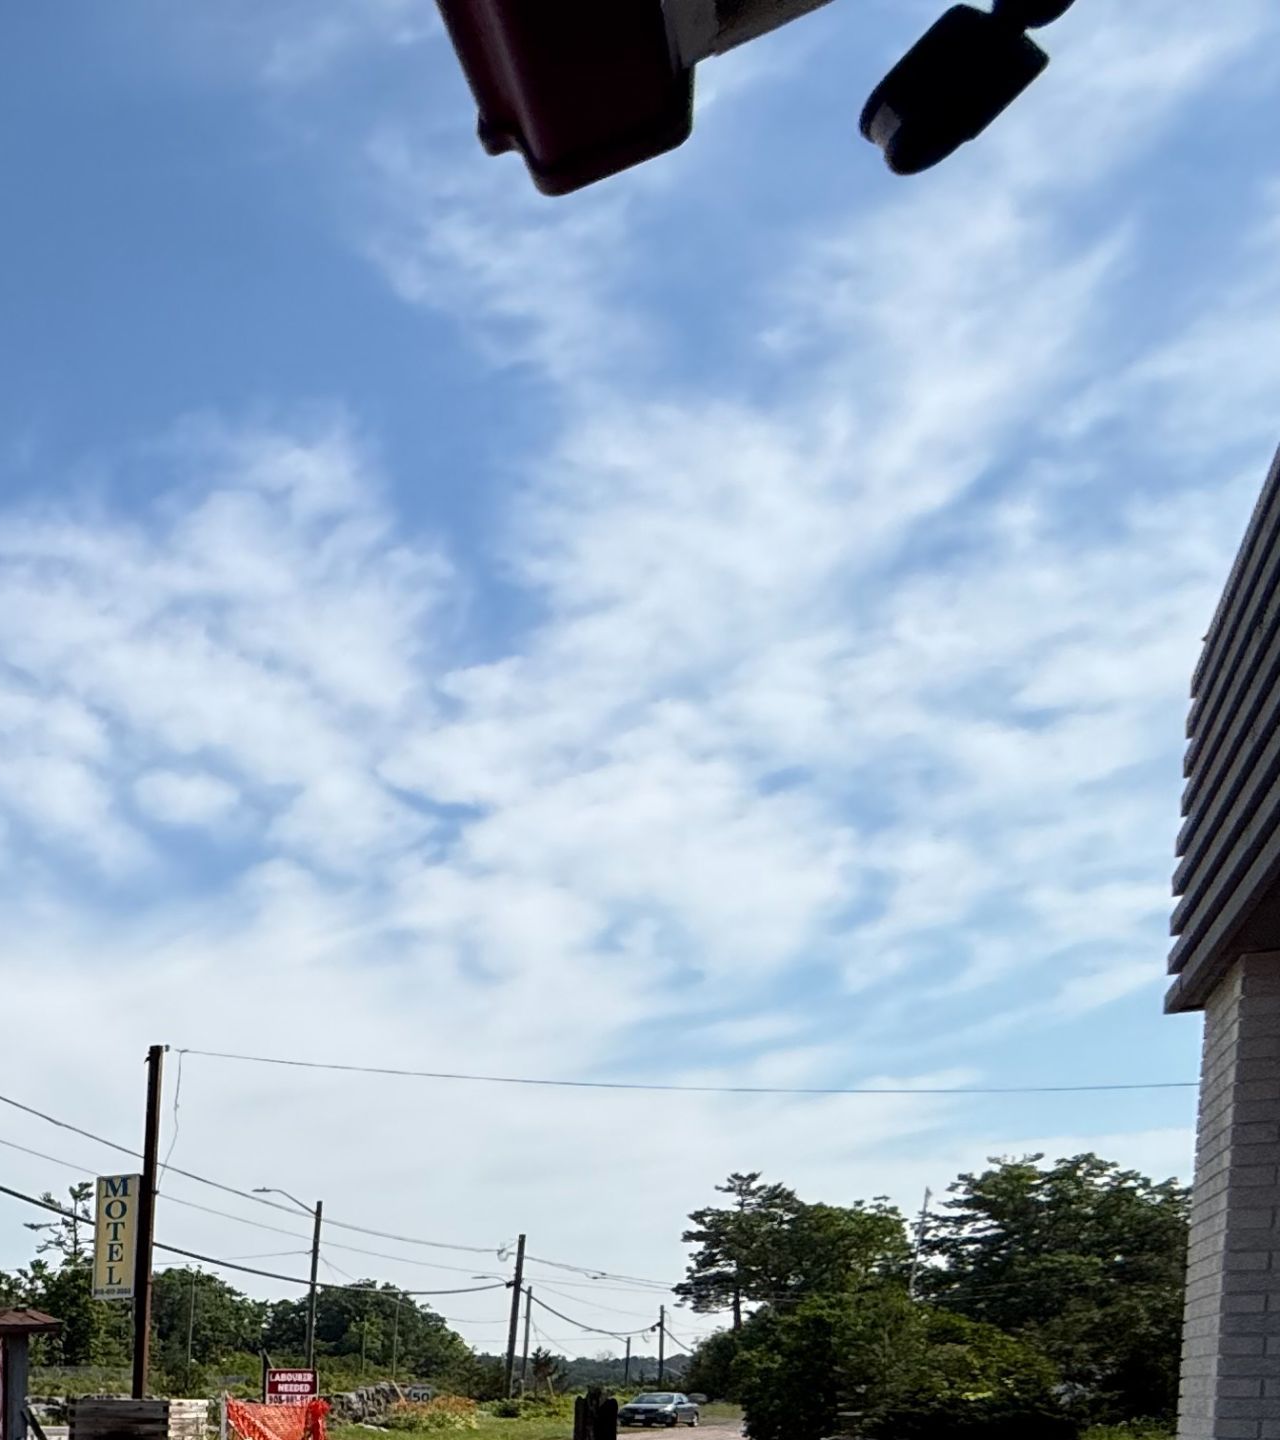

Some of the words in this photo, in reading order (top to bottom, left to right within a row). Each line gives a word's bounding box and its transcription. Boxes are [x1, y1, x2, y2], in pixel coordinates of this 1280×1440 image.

[102, 1176, 131, 1285] MOTEL
[277, 1383, 311, 1392] NEEDED
[412, 1391, 430, 1402] 50
